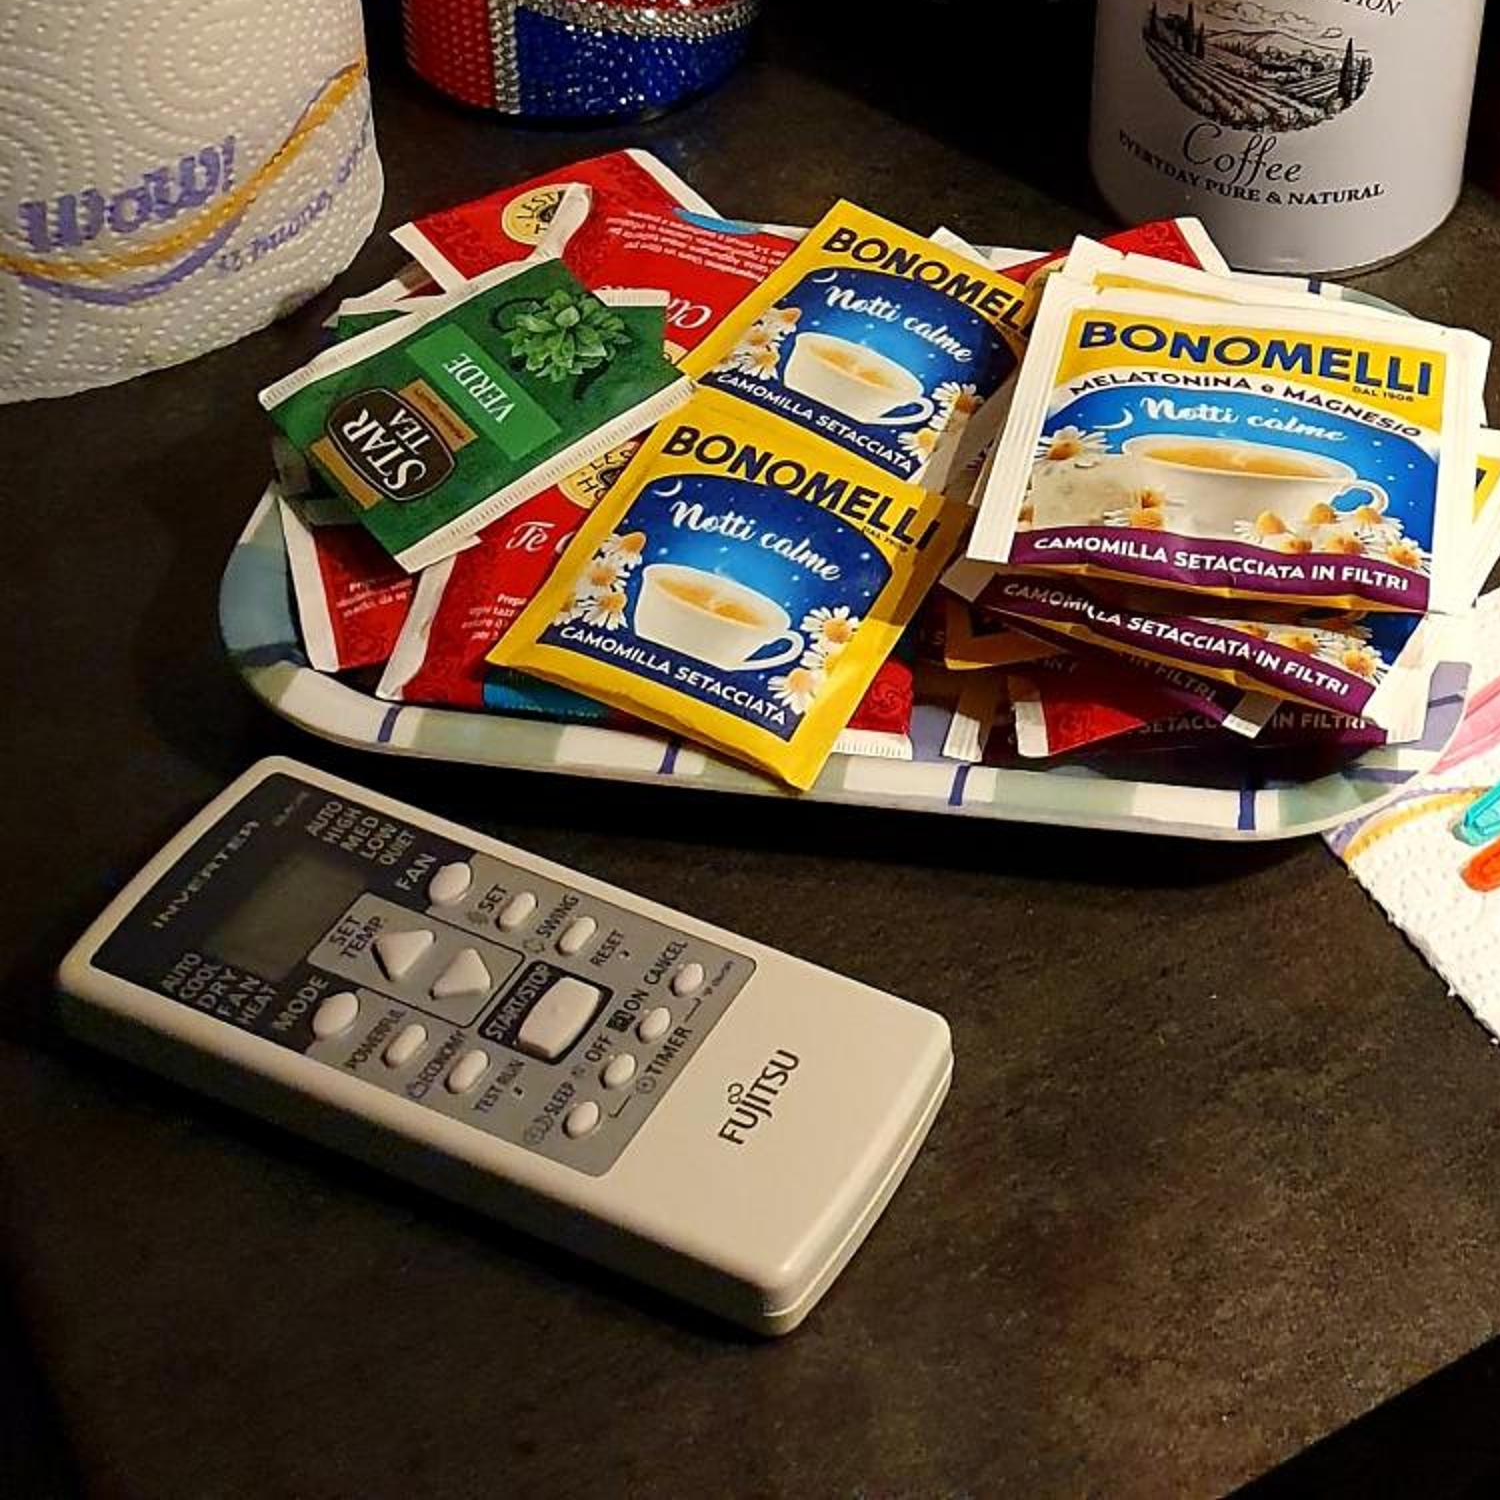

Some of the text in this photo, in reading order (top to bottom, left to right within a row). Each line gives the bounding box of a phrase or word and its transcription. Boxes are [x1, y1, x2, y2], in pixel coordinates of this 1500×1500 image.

[1119, 129, 1384, 205] EVERYDAY PURE & NATURAL
[1183, 122, 1301, 187] Coffee
[822, 226, 1026, 332] BONOMEL
[825, 285, 974, 364] Notti calme
[1079, 321, 1433, 396] BONOMELLI
[442, 353, 515, 423] VERDE
[1069, 371, 1252, 397] MELATONINA
[1283, 387, 1422, 437] MAGNESIO
[389, 408, 431, 455] TEA
[717, 373, 913, 473] CAMOMILLA SETACCIATA
[1140, 397, 1347, 443] Notti calme
[342, 408, 427, 490] STAR
[662, 425, 939, 551] BONOMELLI
[670, 500, 756, 542] Notti
[760, 531, 842, 582] calme
[1034, 536, 1409, 592] CAMOMILLA SETACCIATA IN FILTRI
[1004, 583, 1120, 627] CAMOMILLA
[1127, 617, 1250, 659] SETACCIATA
[1284, 662, 1351, 696] FILTRI
[560, 626, 787, 726] CAMOMILLA SETACCIATA
[305, 801, 343, 837] AUTO
[324, 808, 362, 844] HIGH
[341, 816, 379, 852] MED
[360, 823, 399, 860] LOW
[152, 819, 262, 929] INVERTER
[395, 853, 438, 891] FAN
[478, 884, 508, 914] SET
[536, 894, 579, 938] SWING
[330, 915, 362, 946] SET
[590, 930, 625, 967] RESET
[160, 952, 202, 993] AUTO
[198, 967, 238, 1010] DRY
[644, 940, 688, 985] CANCEL
[216, 976, 262, 1017] FAN
[271, 976, 329, 1031] MODE
[585, 1034, 614, 1063] OFF
[646, 1026, 693, 1077] TIMER
[718, 1049, 801, 1145] FUJITSU
